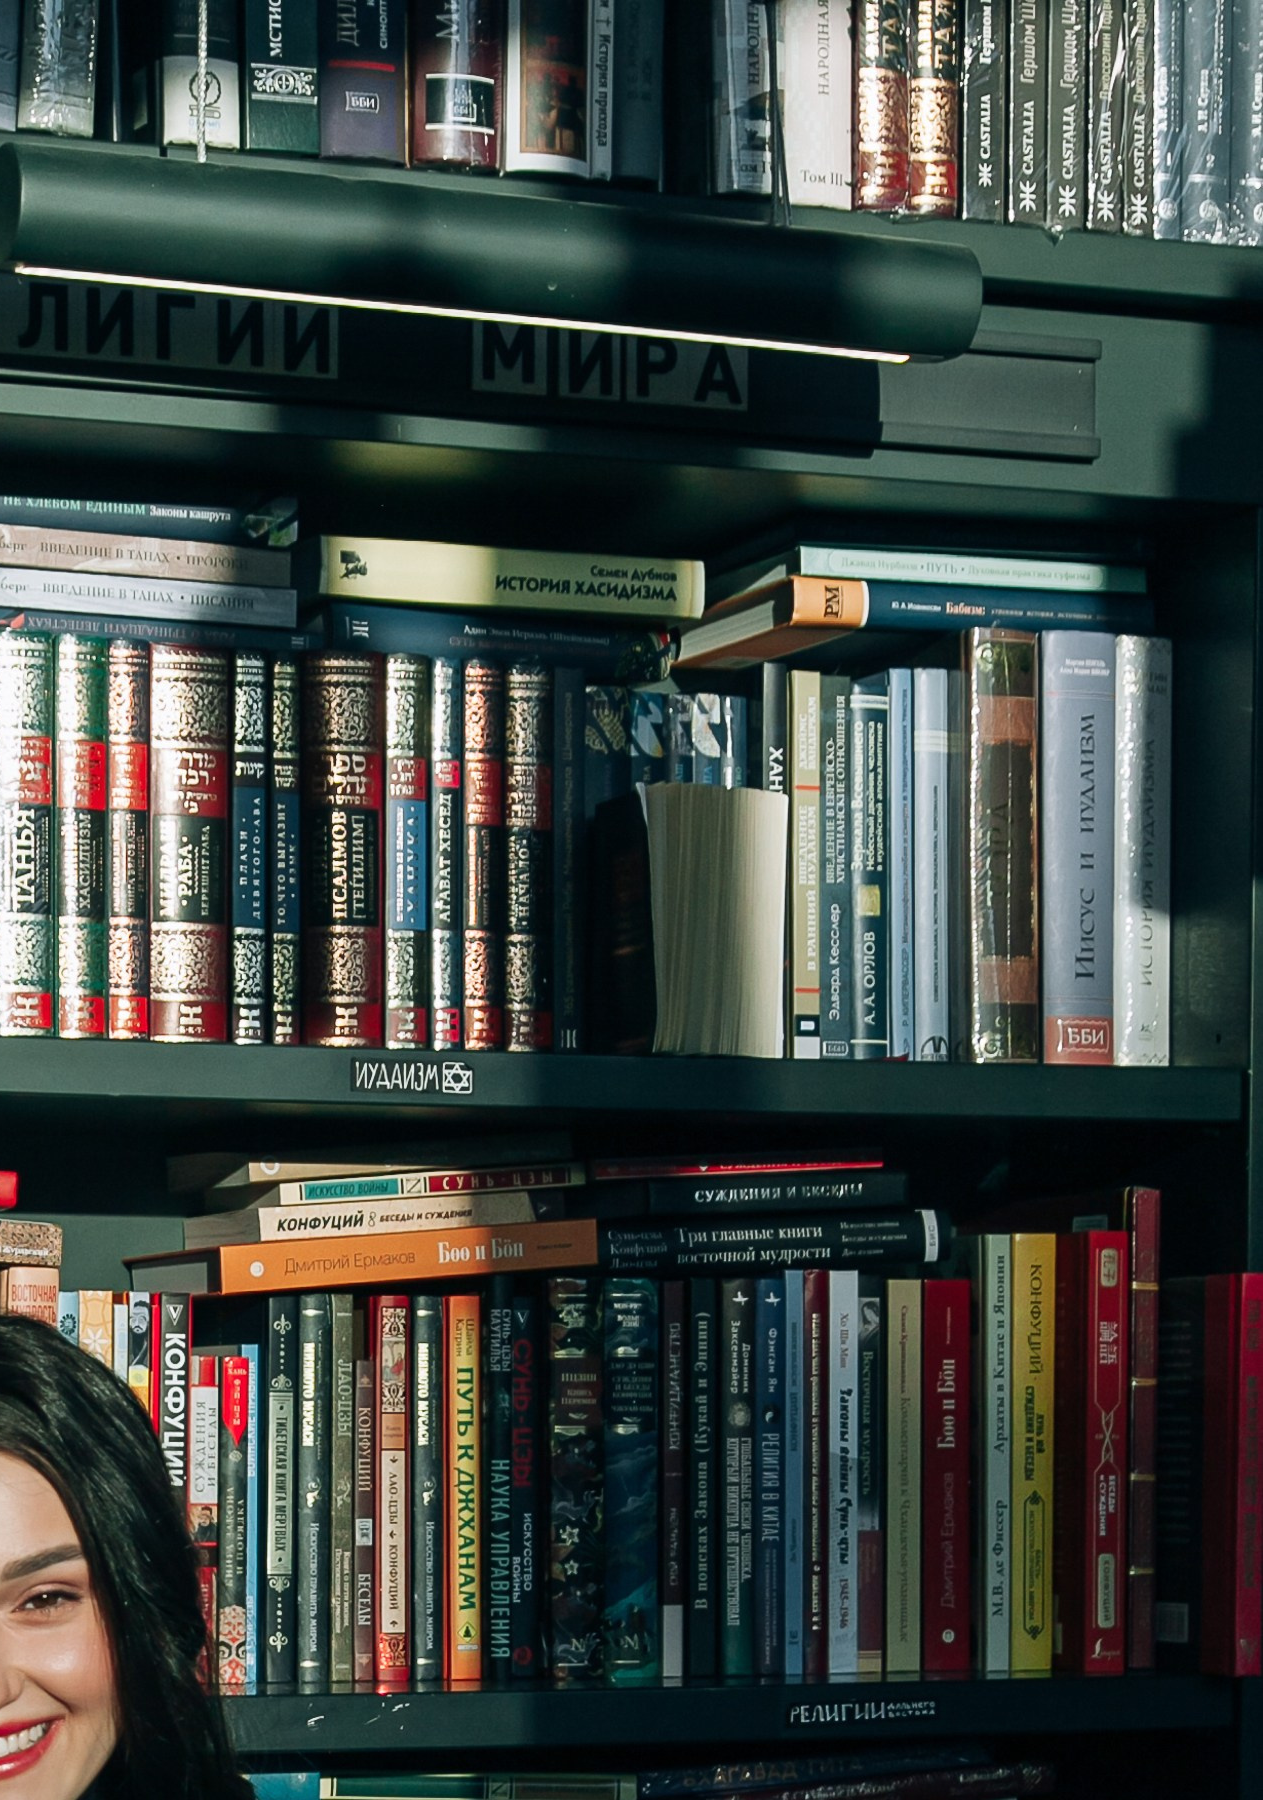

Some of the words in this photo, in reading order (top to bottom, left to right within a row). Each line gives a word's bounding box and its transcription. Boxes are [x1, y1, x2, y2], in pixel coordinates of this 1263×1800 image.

[980, 95, 991, 158] CASTALIA
[1022, 101, 1034, 174] CASTALIA
[1061, 105, 1074, 179] CASTALIA
[482, 320, 742, 404] МИРА
[495, 574, 570, 594] ИСТОРИЯ
[575, 579, 677, 602] ХАСИДИЗМА
[331, 811, 348, 919] ПСАЛМОВ
[863, 932, 876, 988] ОРЛОВ
[356, 1061, 439, 1091] ИУДАИЗМ
[277, 1210, 364, 1233] КОНФУЦИЙ
[675, 1227, 706, 1247] Три
[712, 1227, 774, 1241] главные
[779, 1226, 823, 1241] книги
[354, 1251, 416, 1269] Ермаков
[455, 1367, 475, 1436] ПУТЬ
[357, 1407, 371, 1491] КОНФУЦИЙ
[455, 1444, 475, 1459] К
[492, 1459, 510, 1520] НАУКА
[453, 1467, 476, 1611] ДЖХАНАМ
[358, 1574, 370, 1626] БЕСЕДЫ
[790, 1702, 886, 1723] РЕЛИГИИ
